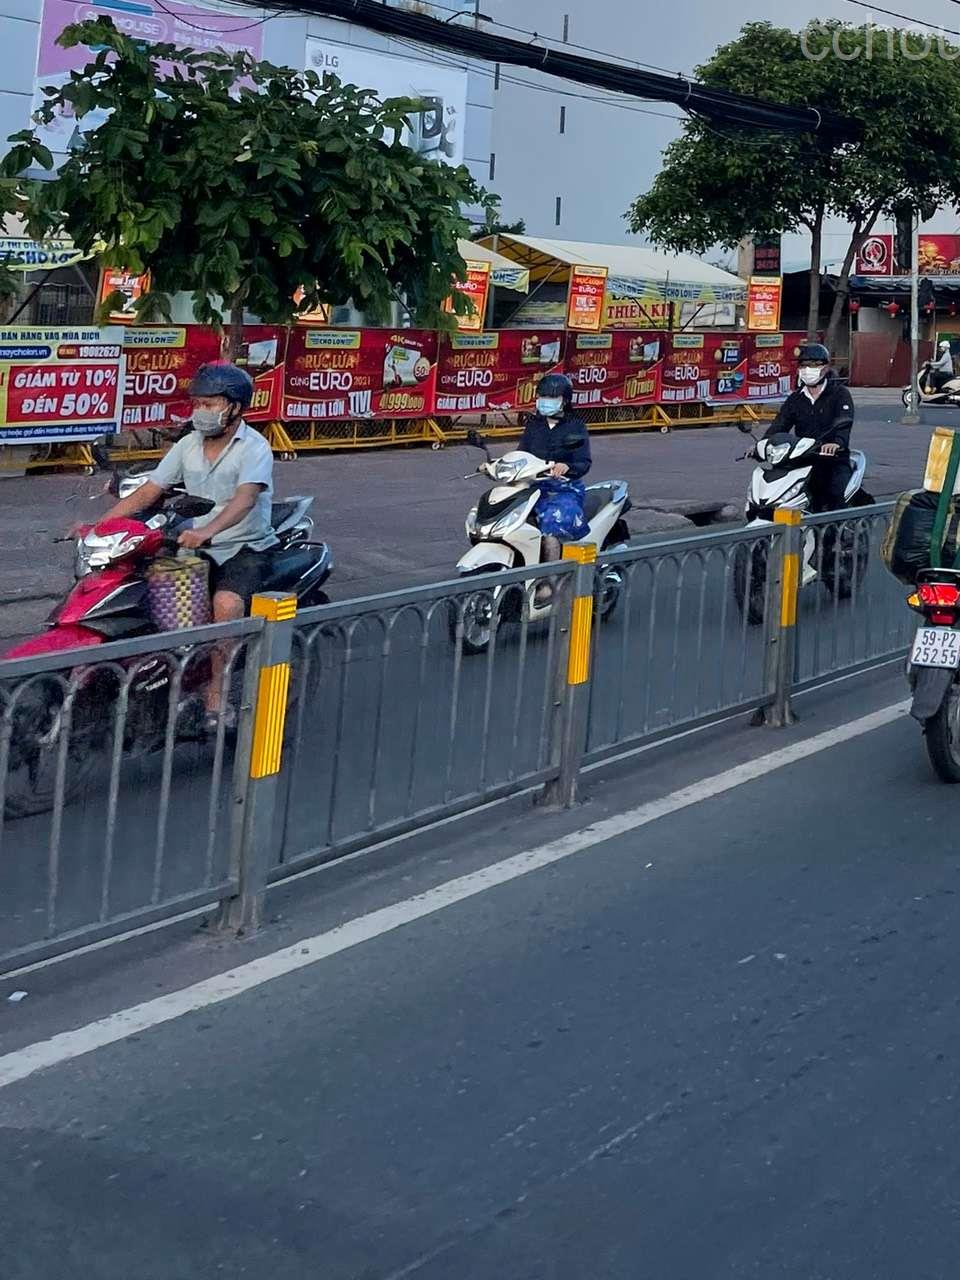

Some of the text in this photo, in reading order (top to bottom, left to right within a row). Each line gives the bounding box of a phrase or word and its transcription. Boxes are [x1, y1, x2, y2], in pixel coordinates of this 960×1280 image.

[325, 54, 339, 68] LG
[14, 368, 117, 388] GIẢM TỪ 10%
[457, 370, 493, 387] EURO
[579, 368, 607, 384] EURO
[675, 366, 699, 380] EURO
[759, 363, 780, 377] EURO
[124, 373, 177, 396] EURO
[309, 372, 352, 391] EURO
[21, 391, 109, 416] ĐẾN 50%
[922, 630, 957, 648] 59-P2
[913, 647, 957, 665] 252.55
